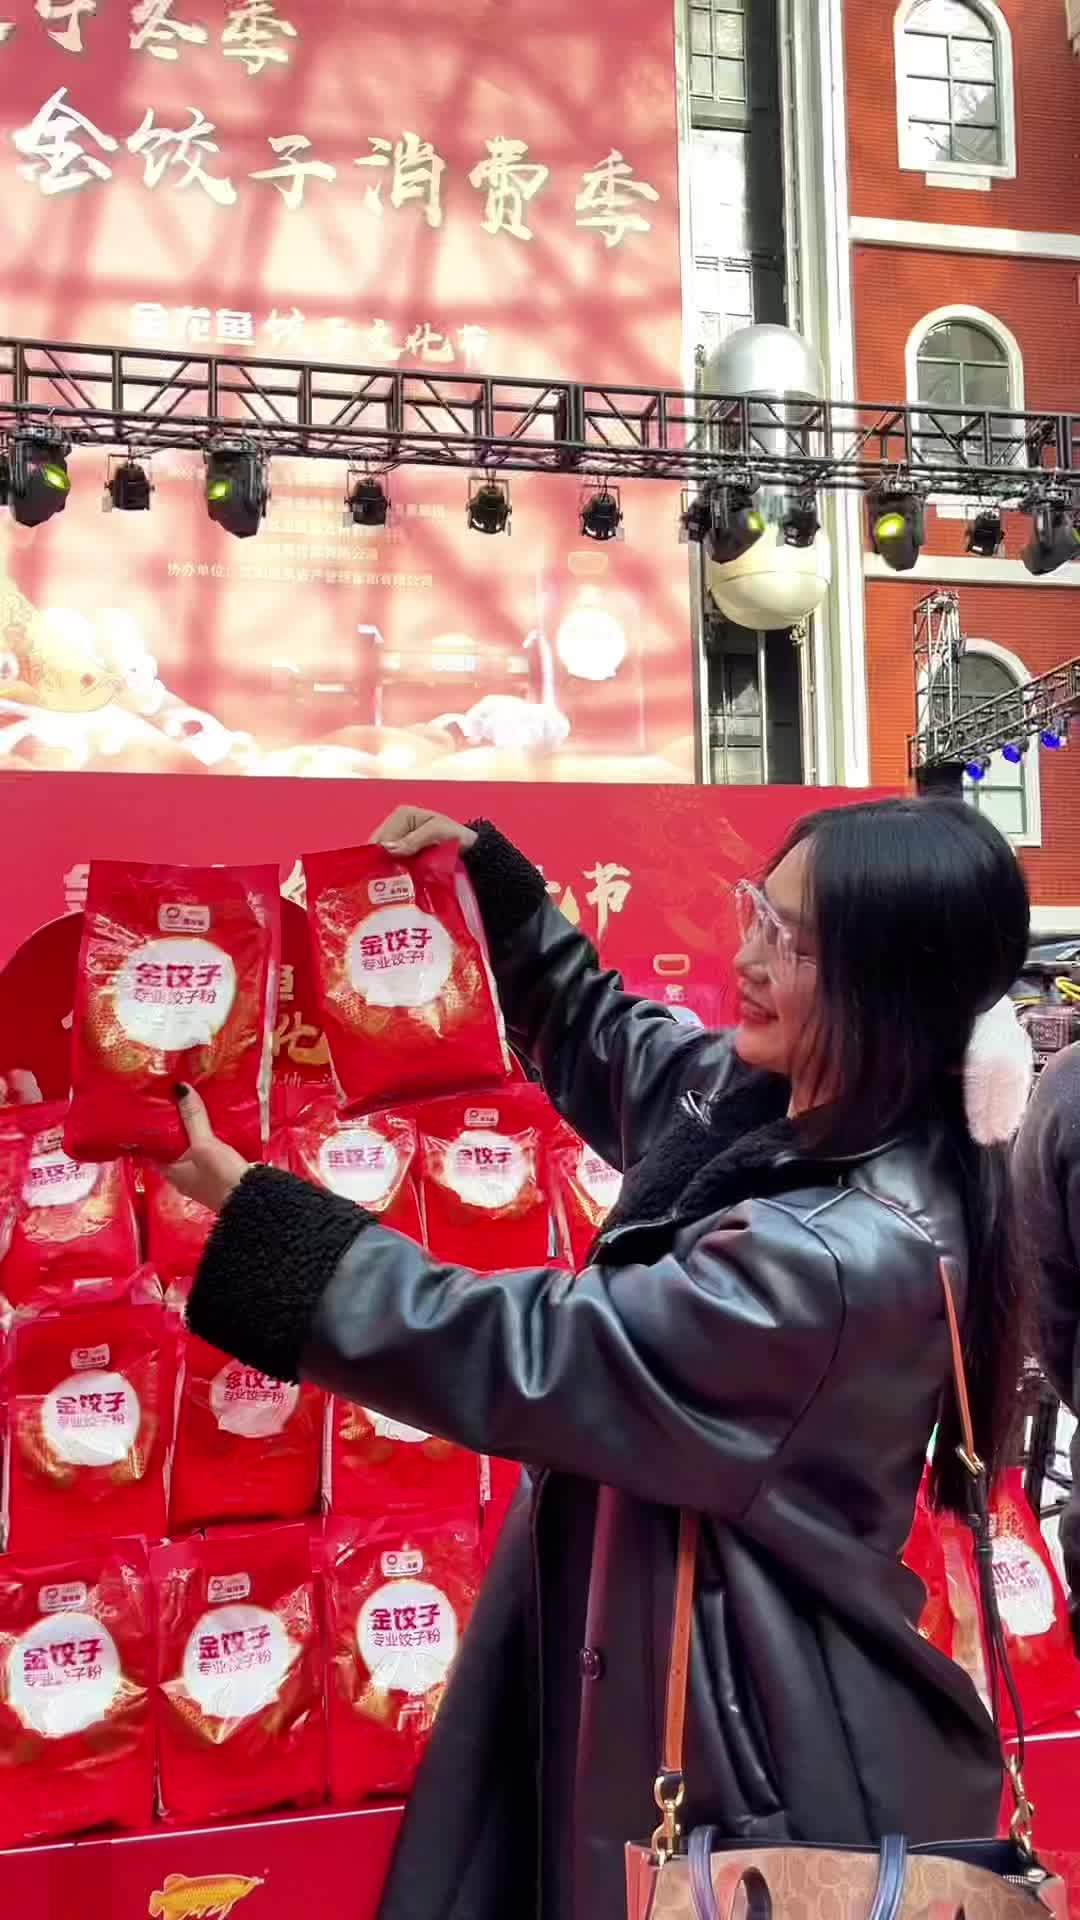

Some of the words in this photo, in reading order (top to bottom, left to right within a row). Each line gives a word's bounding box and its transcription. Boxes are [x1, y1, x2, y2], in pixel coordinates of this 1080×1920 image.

[10, 86, 660, 248] 金饺子消费季
[360, 928, 433, 957] 金饺子
[361, 950, 425, 971] 专业饺子
[135, 962, 222, 988] 金饺子
[56, 1391, 125, 1414] 金饺子
[370, 1603, 441, 1631] 金饺子
[199, 1624, 271, 1660] 金饺子
[372, 1628, 441, 1648] 专业饺子粉
[23, 1638, 102, 1671] 金饺子
